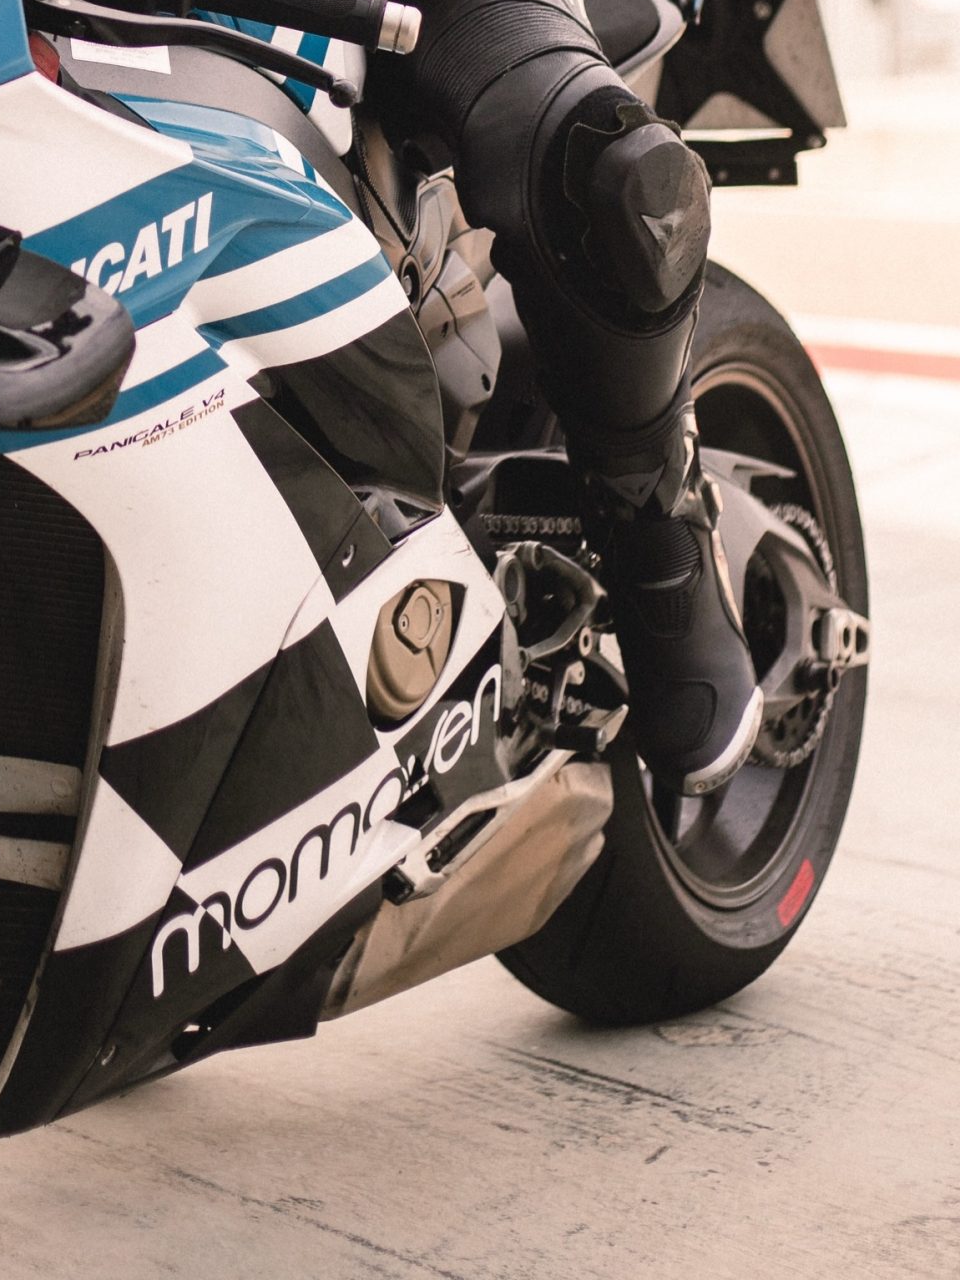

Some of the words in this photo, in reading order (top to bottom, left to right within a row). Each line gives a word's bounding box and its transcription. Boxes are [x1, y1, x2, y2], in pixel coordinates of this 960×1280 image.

[70, 191, 214, 296] CATI
[73, 405, 195, 461] PANIGALE
[201, 387, 226, 407] V4
[141, 427, 176, 448] AM73
[178, 399, 225, 430] EDITION
